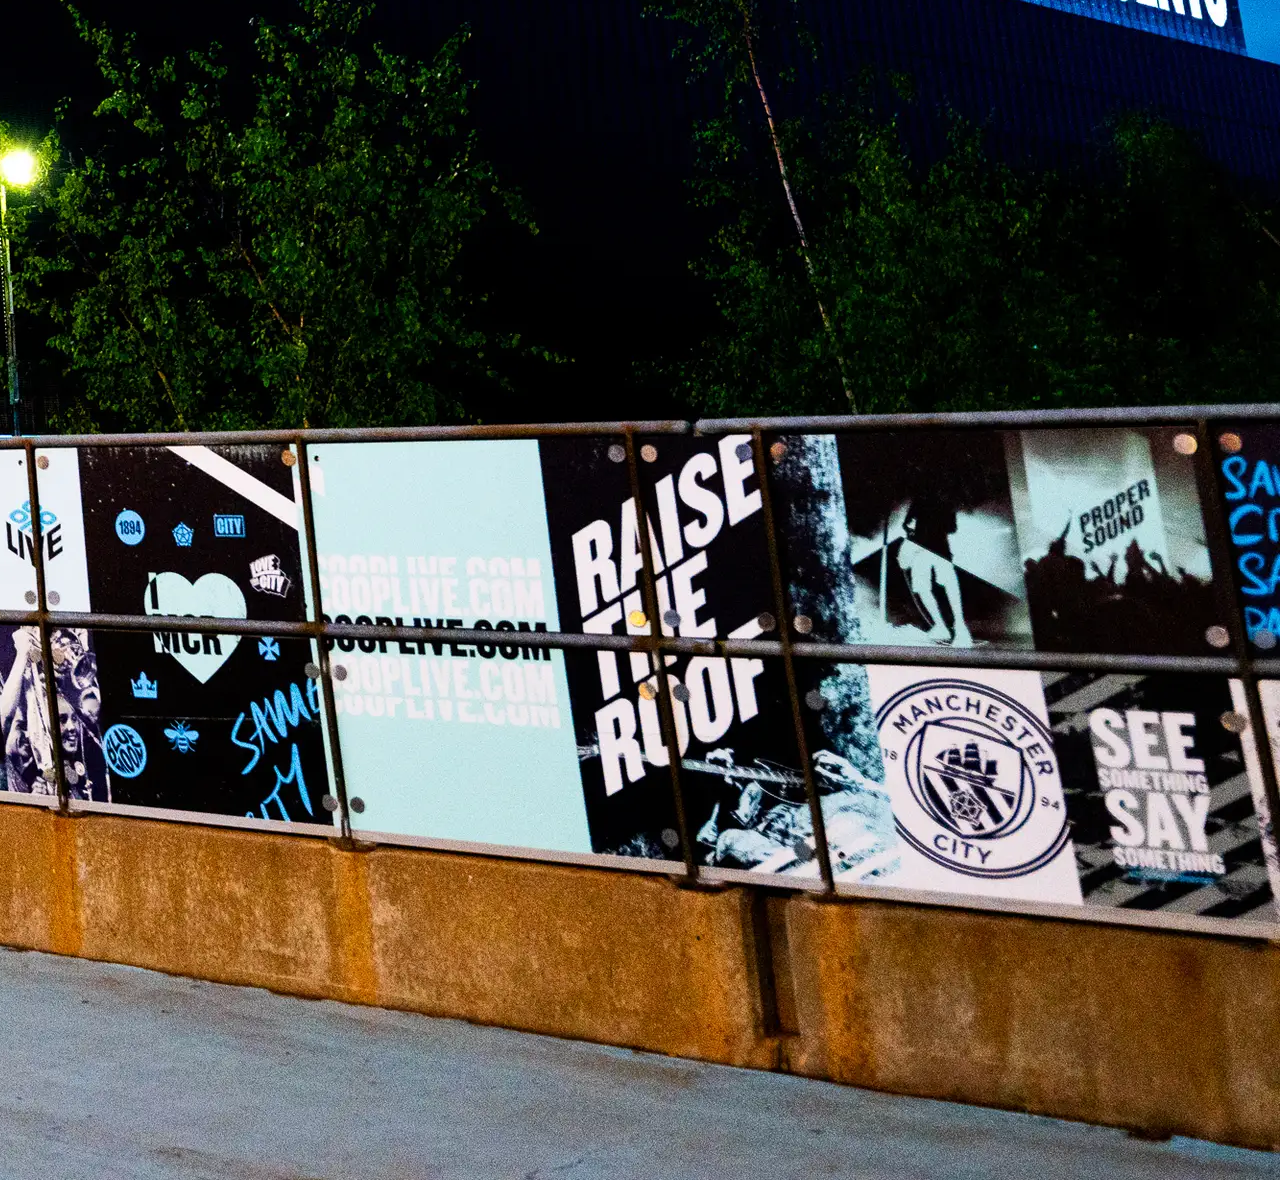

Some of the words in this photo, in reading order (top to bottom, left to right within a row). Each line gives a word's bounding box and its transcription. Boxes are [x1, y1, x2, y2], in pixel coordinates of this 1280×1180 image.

[1079, 478, 1151, 534] PROPER
[119, 520, 142, 535] 1894
[216, 519, 242, 535] CITY
[571, 434, 764, 618] RAISE
[1082, 504, 1145, 554] SOUND
[249, 554, 277, 578] LOVE
[259, 575, 286, 593] CITY
[106, 728, 141, 765] BLUE
[893, 694, 1055, 776] MANCHESTER
[1089, 707, 1206, 773] SEE
[1098, 767, 1211, 794] SOMETHING
[1040, 796, 1060, 811] 94
[1104, 788, 1212, 853] SAY
[933, 833, 993, 865] CITY
[1112, 846, 1227, 875] SOMETHING
